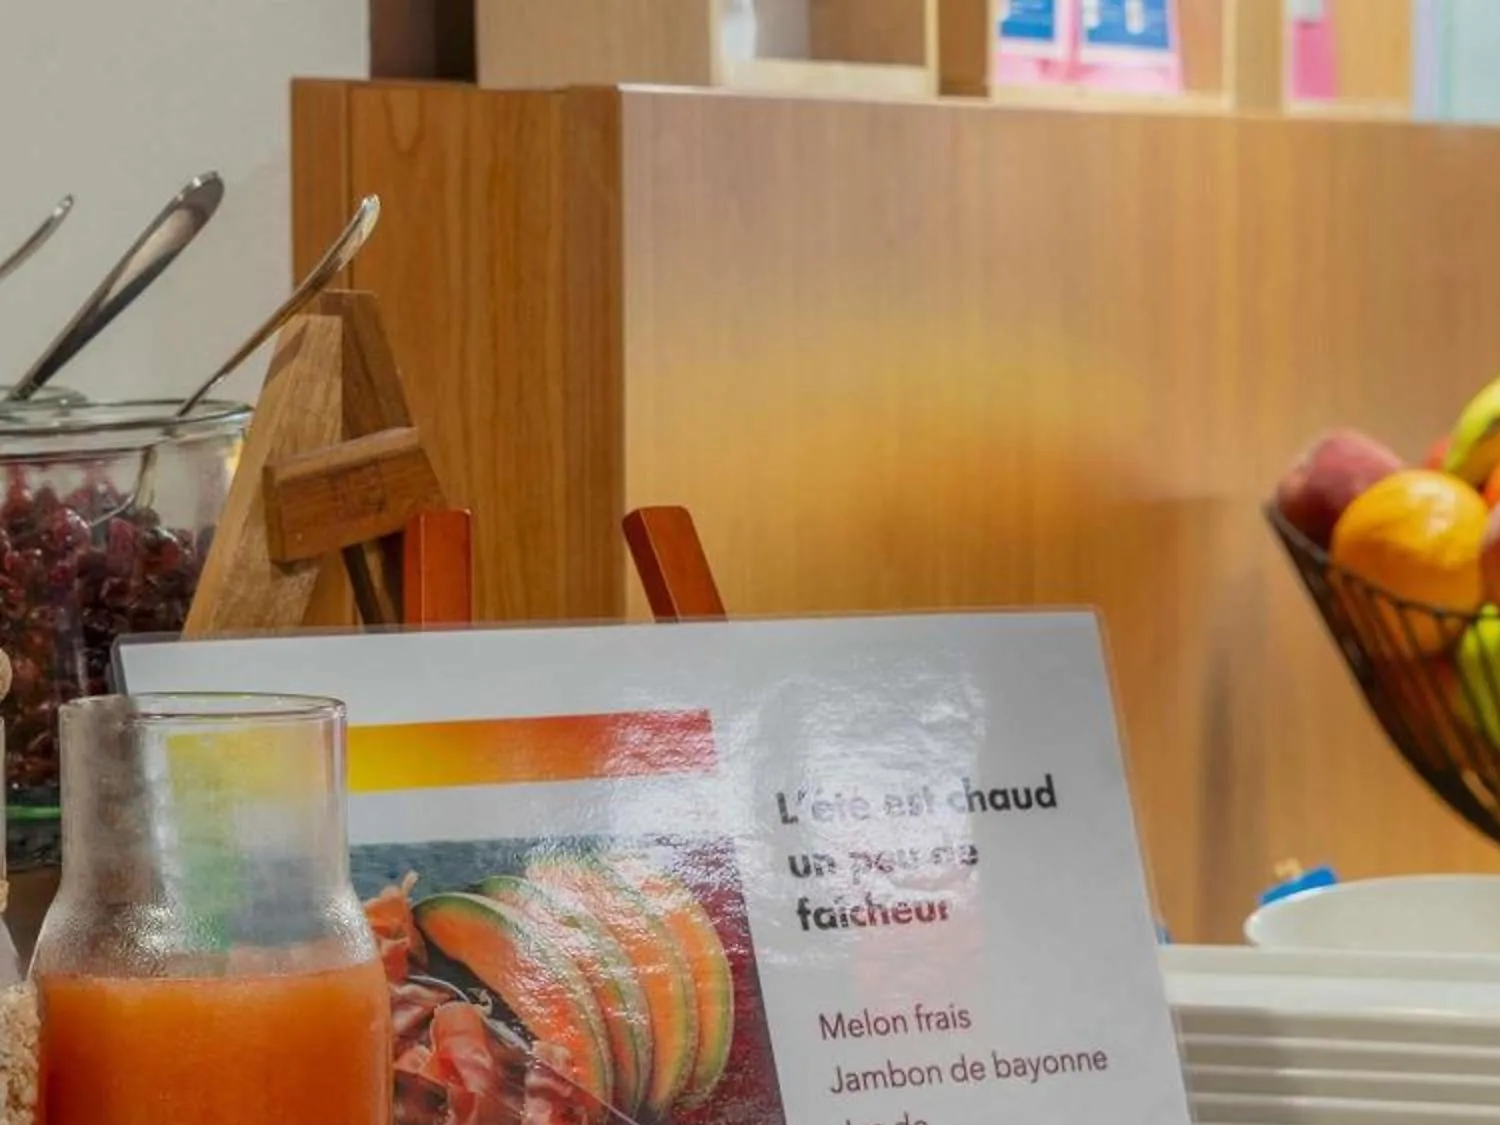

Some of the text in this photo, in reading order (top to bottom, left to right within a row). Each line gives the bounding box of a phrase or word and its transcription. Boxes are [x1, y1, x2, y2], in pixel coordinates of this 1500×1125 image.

[946, 774, 1058, 813] chaud
[788, 852, 836, 879] un
[819, 1003, 972, 1041] Melon frais
[830, 1047, 1109, 1095] Jambon de bayonne
